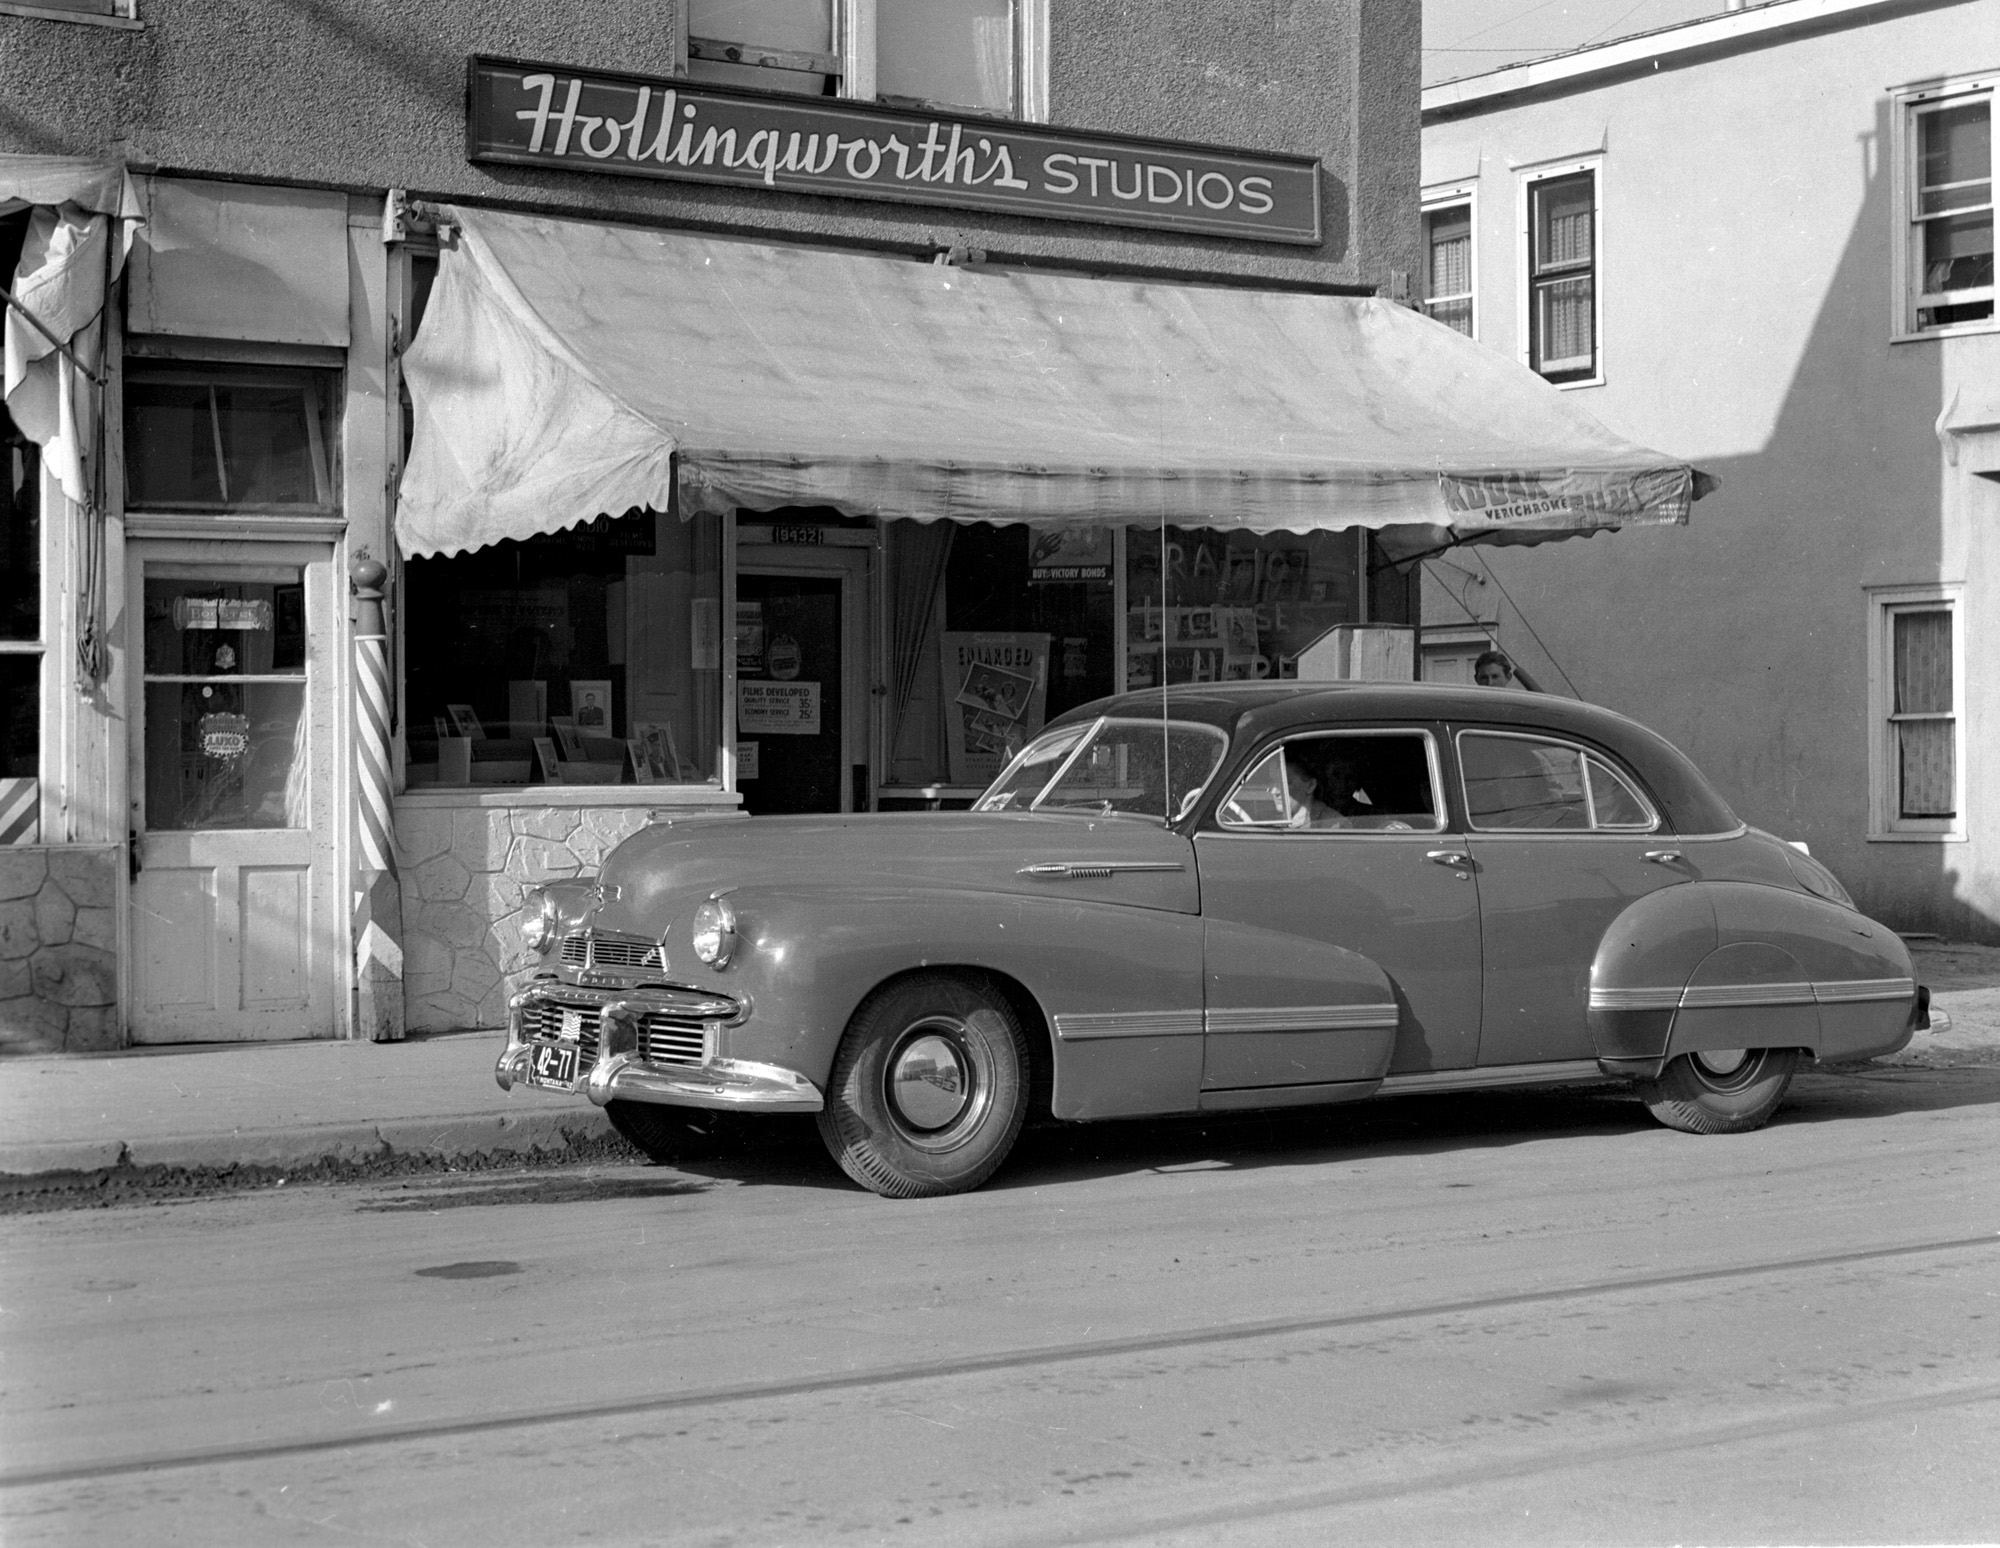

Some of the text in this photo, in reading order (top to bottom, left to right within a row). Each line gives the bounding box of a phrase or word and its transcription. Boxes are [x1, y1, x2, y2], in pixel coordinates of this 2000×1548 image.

[516, 74, 1274, 214] Hollingworth's STUDIOS
[1441, 471, 1549, 512] KODAK
[1485, 498, 1568, 520] VERICHROME
[780, 529, 816, 542] 9432
[1032, 567, 1106, 578] BUY VICTORY BONDS
[958, 646, 1033, 666] ENLARGED
[742, 687, 810, 697] FILMS DEVELOPED
[537, 1046, 572, 1079] 42-77
